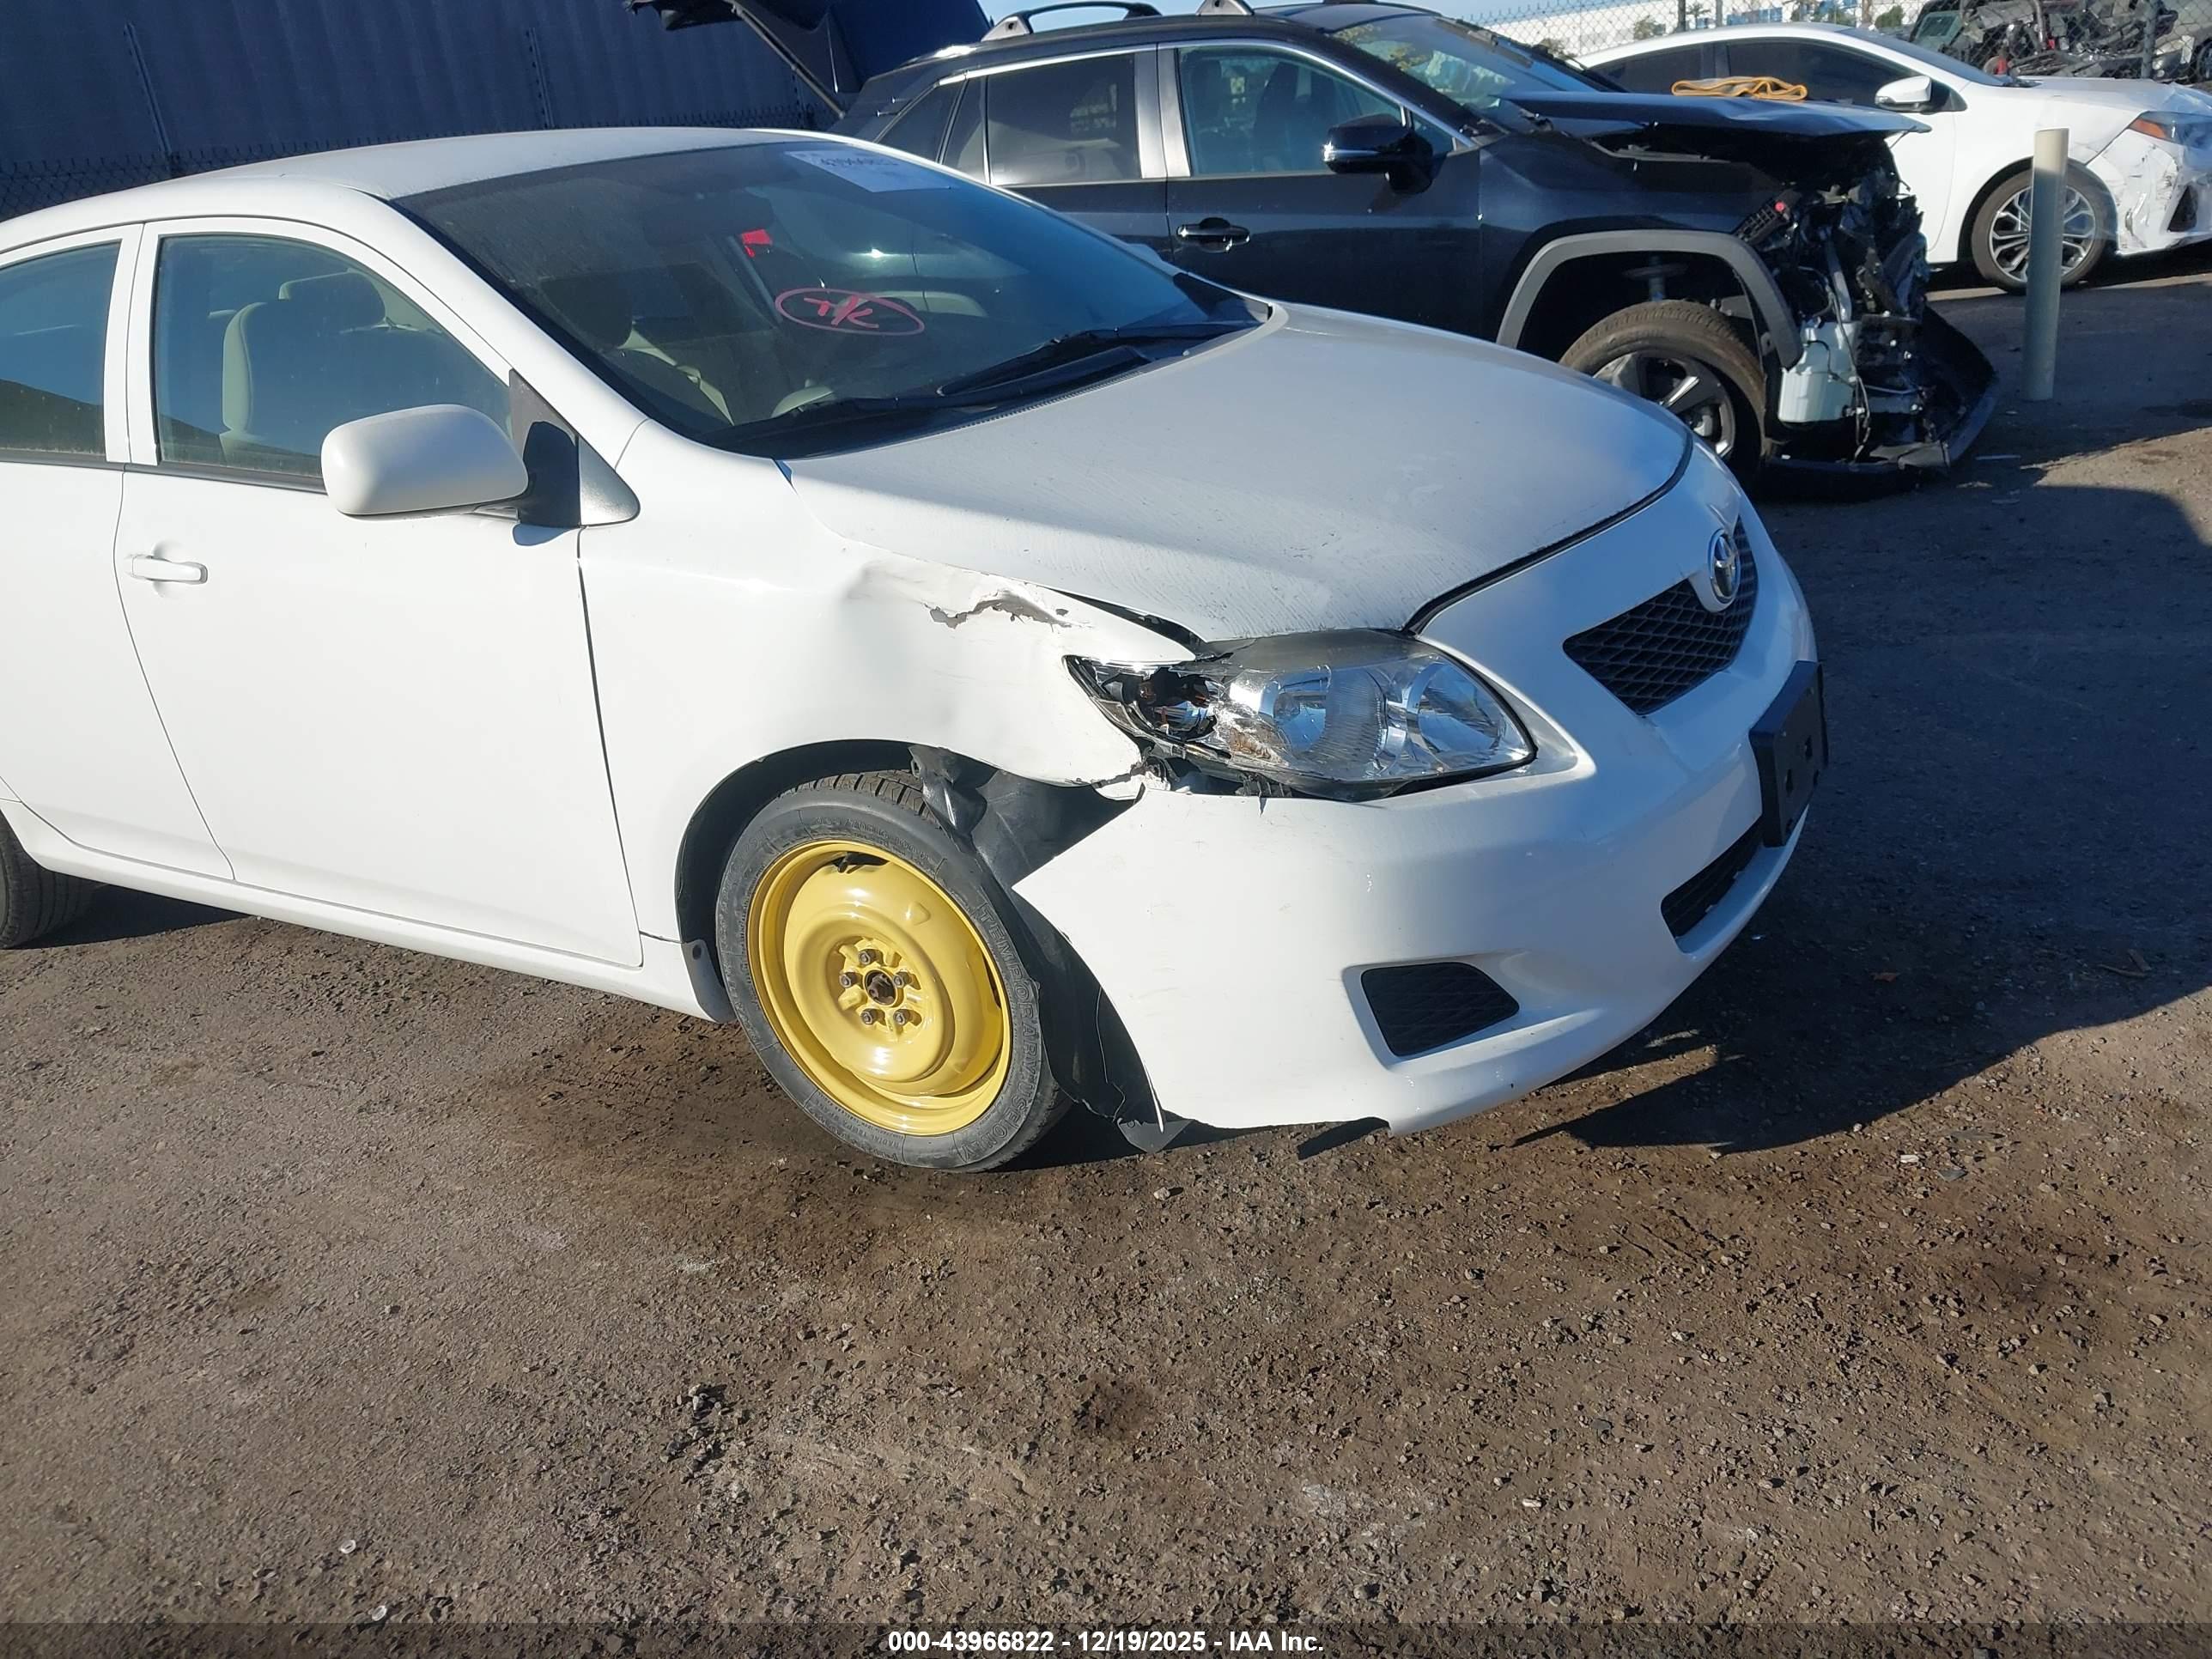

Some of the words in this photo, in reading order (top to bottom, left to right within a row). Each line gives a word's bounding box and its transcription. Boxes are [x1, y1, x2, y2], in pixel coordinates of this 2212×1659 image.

[976, 908, 1038, 1076] TEMPORARY
[1001, 1077, 1034, 1127] USE
[957, 1119, 1011, 1163] ONLY
